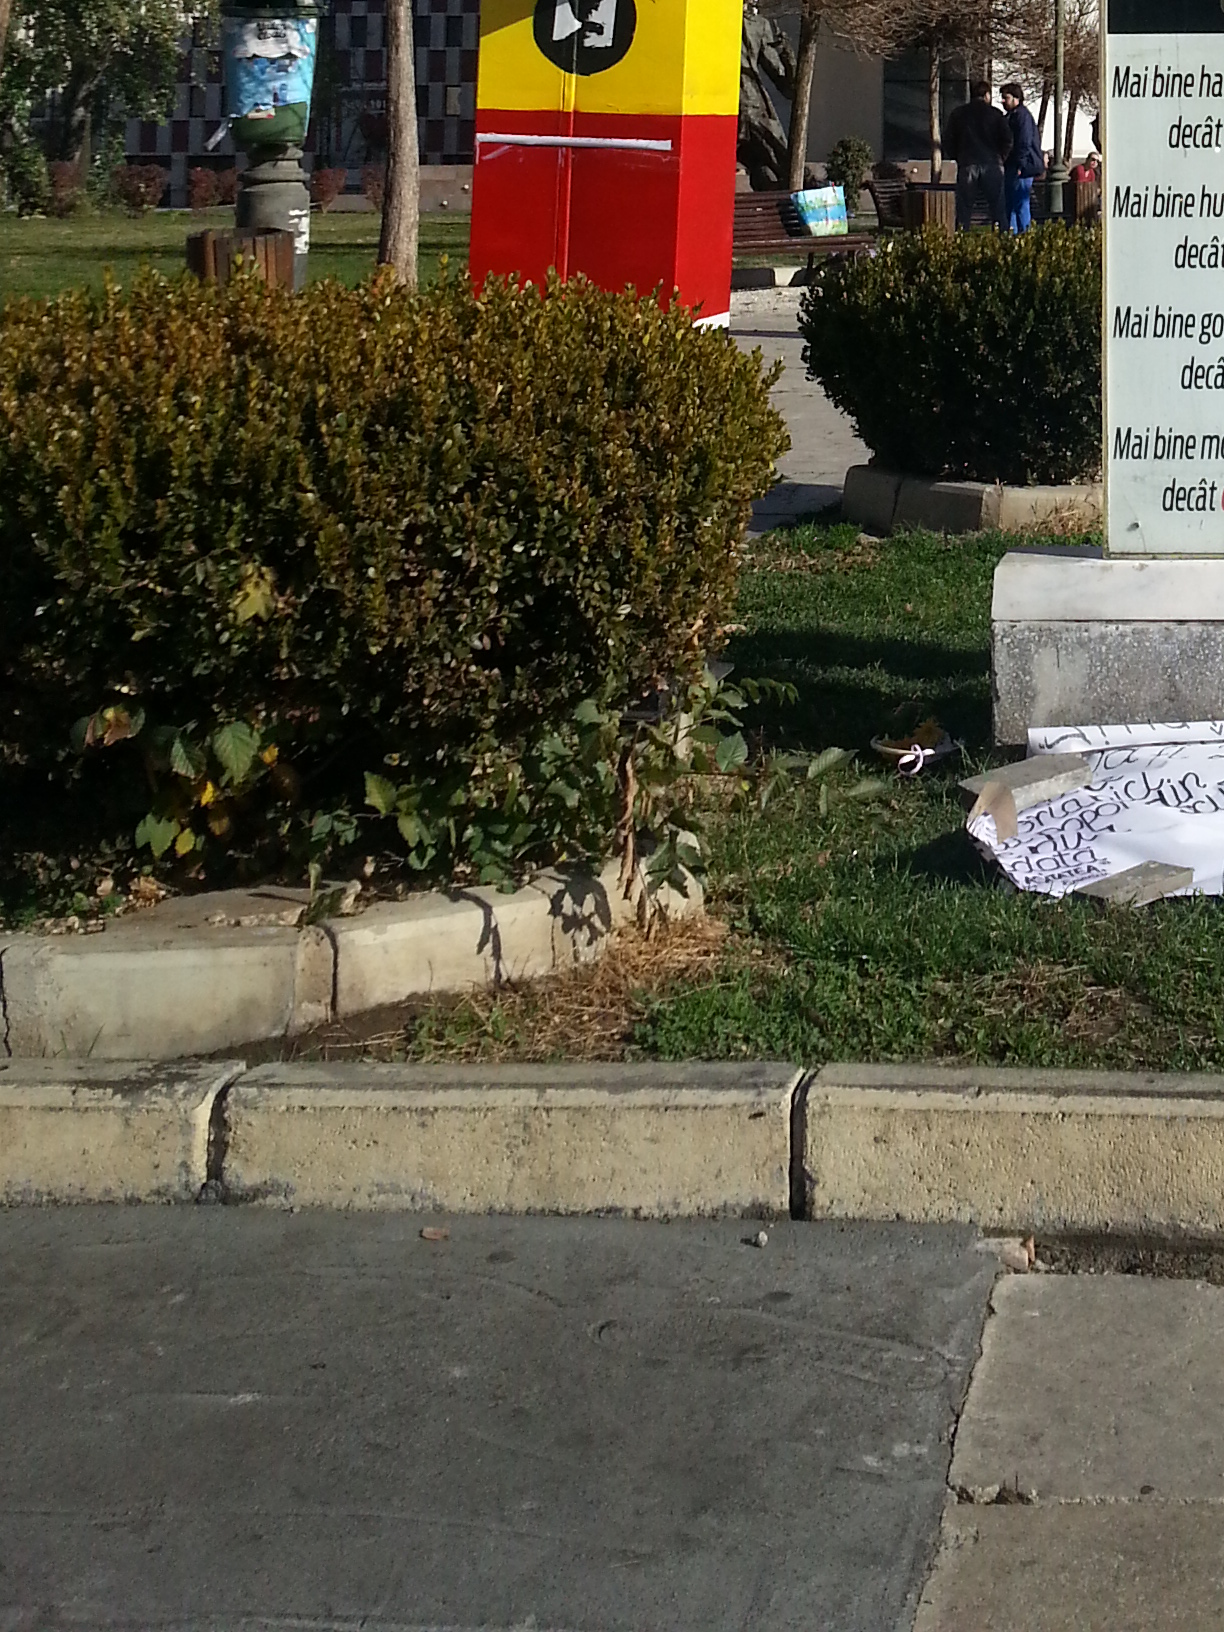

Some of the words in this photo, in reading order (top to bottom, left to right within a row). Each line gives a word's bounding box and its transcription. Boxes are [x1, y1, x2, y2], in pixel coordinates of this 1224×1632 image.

[1112, 66, 1149, 98] Mai
[1152, 65, 1195, 98] bine
[1169, 116, 1223, 149] decât
[1113, 186, 1149, 218] Mai
[1152, 185, 1195, 218] bine
[1113, 306, 1150, 338] Mai
[1153, 305, 1196, 338] bine
[1113, 427, 1150, 460] Mai
[1153, 426, 1197, 460] bine
[1162, 478, 1217, 512] decât
